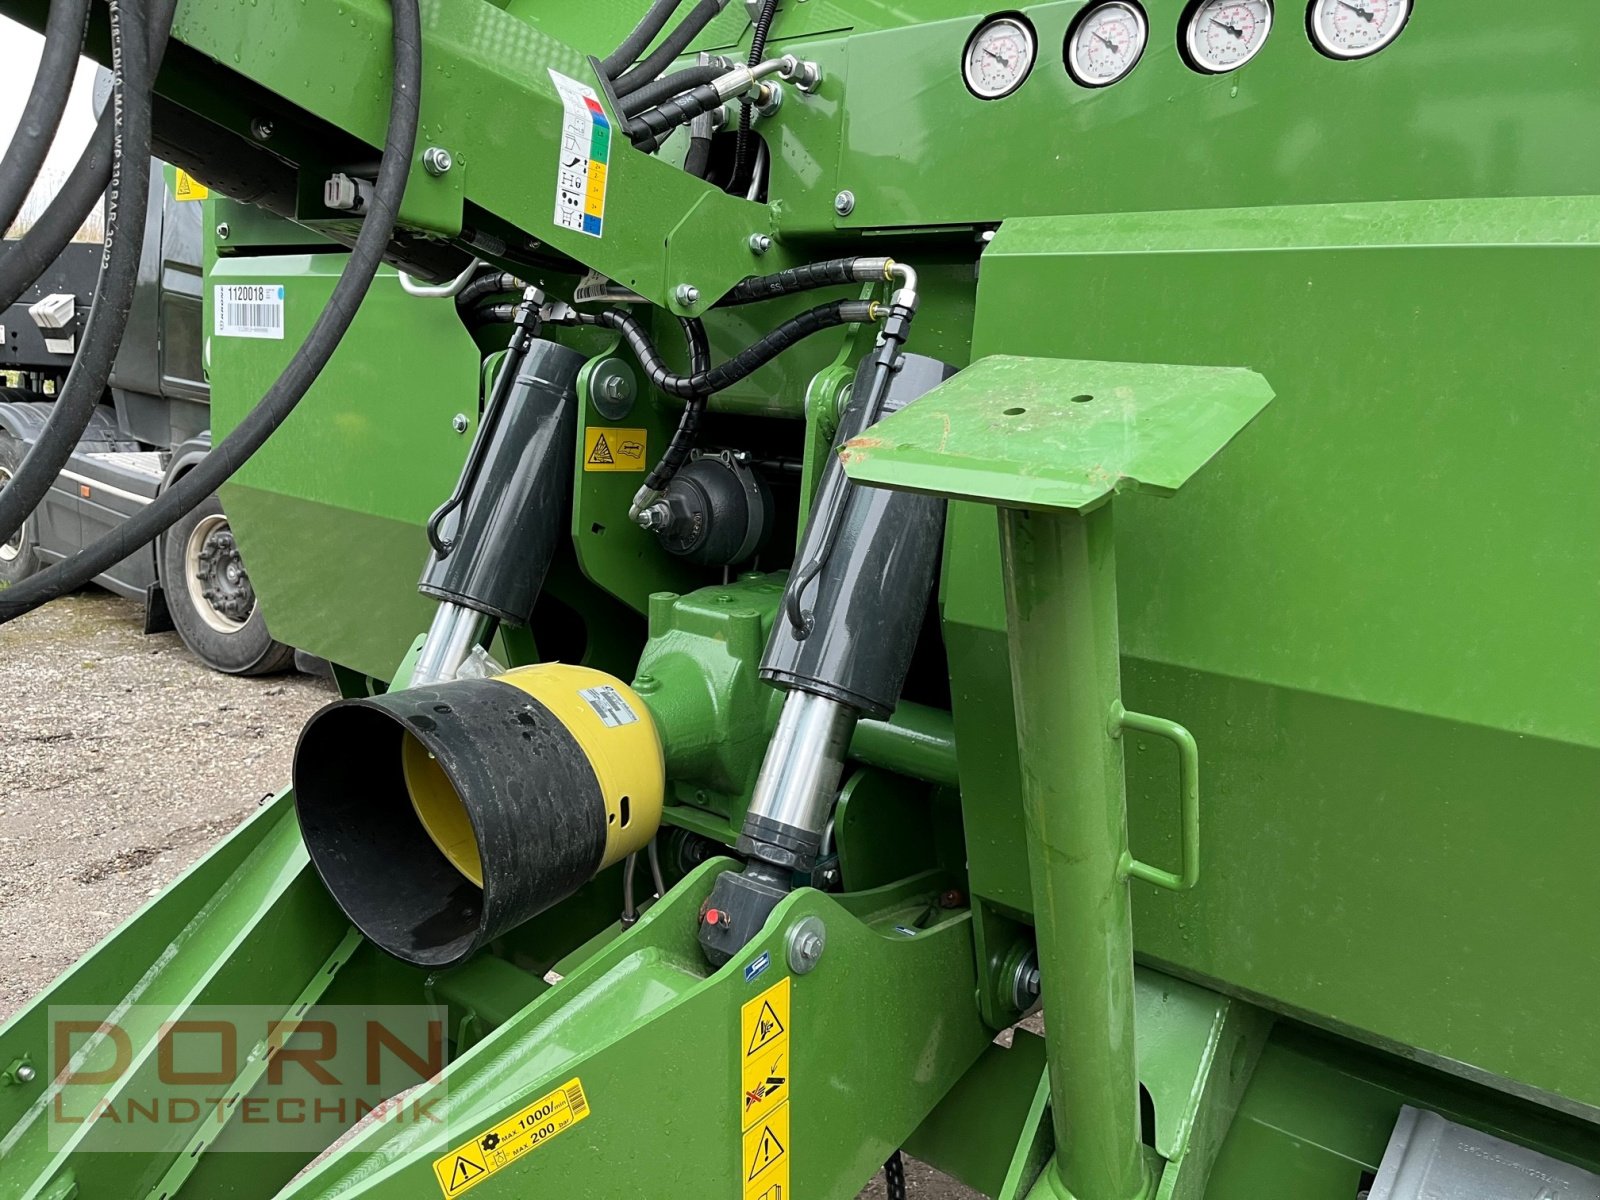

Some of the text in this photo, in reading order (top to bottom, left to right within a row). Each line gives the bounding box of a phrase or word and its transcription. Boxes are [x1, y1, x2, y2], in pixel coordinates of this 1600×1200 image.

[113, 48, 124, 86] DN10
[114, 95, 124, 126] MAX
[114, 134, 122, 159] WP
[112, 162, 121, 186] 330
[108, 191, 119, 222] BAR
[228, 286, 264, 301] 1120018
[530, 1122, 555, 1144] 200
[558, 1118, 570, 1129] bar
